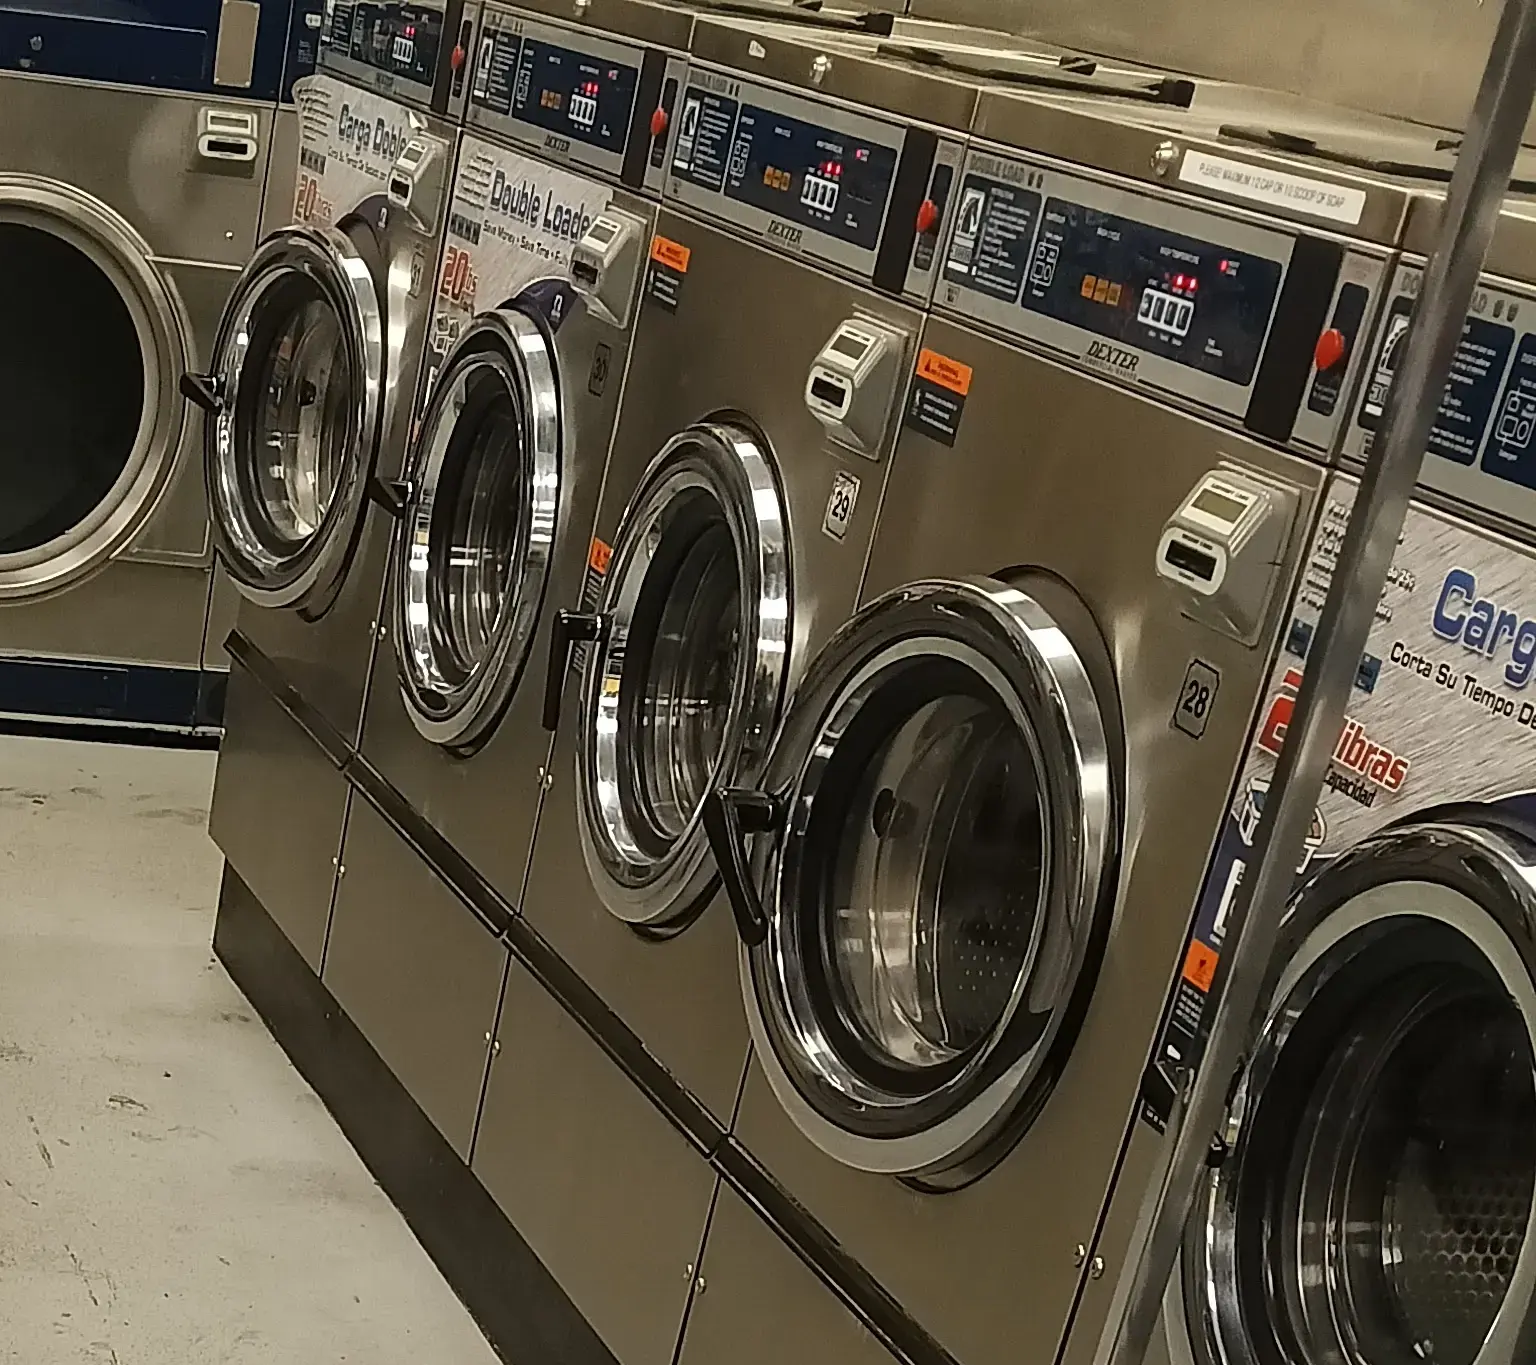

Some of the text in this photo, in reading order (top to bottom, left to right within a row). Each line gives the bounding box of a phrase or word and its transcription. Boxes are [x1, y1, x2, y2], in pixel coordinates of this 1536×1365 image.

[339, 104, 371, 151] Carga
[490, 169, 541, 225] Double
[542, 189, 591, 240] Loade
[768, 219, 803, 244] DEXTER
[1086, 340, 1140, 372] DEXTER
[831, 490, 850, 522] 29
[1433, 568, 1536, 688] Carg
[1182, 679, 1210, 719] 28
[1391, 642, 1433, 678] Corta
[1435, 663, 1458, 690] Su
[1462, 674, 1515, 718] Tiempo
[1336, 721, 1408, 791] ibras
